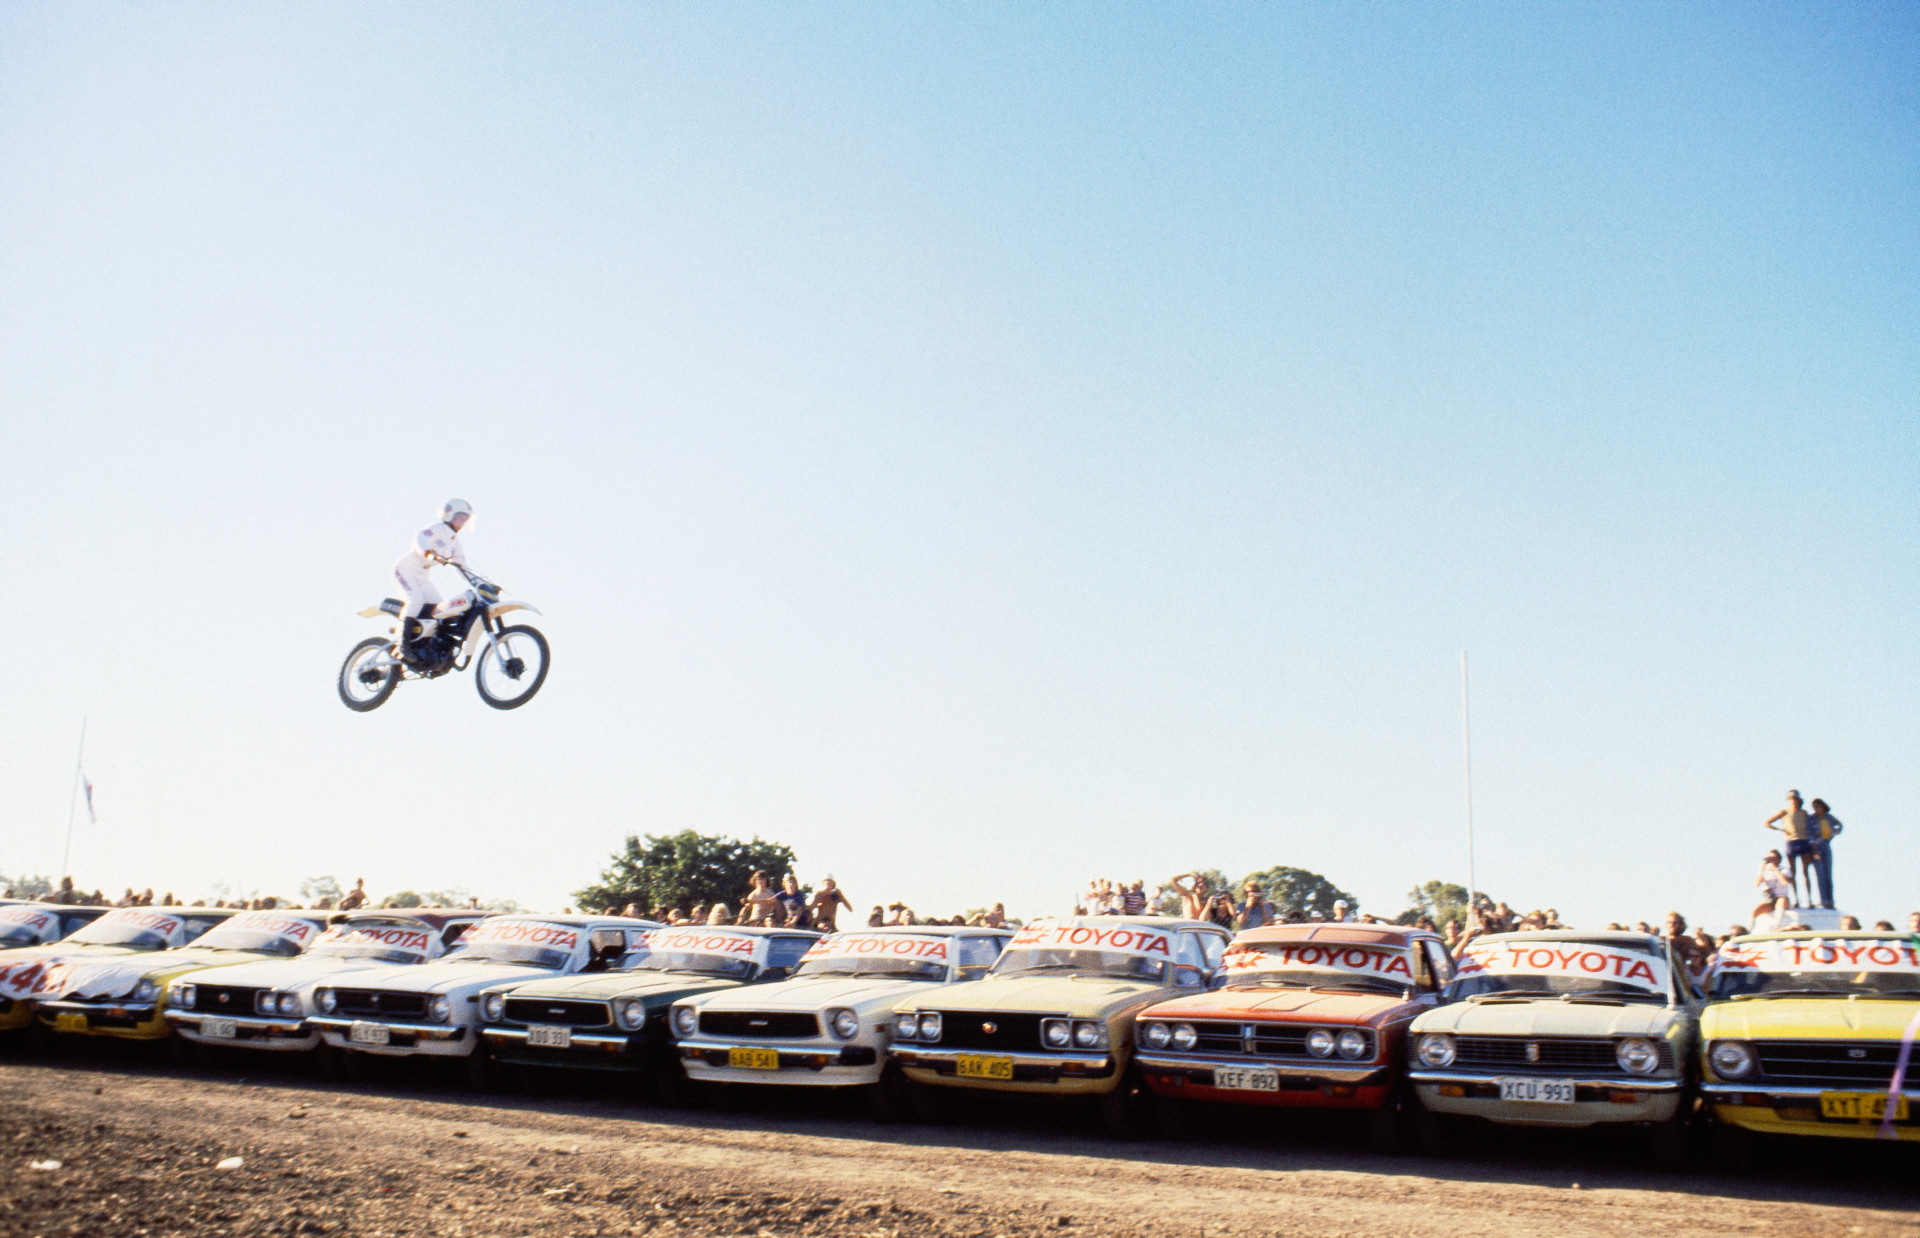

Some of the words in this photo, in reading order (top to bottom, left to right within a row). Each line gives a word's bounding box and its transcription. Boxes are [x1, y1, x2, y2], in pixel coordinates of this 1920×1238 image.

[490, 925, 579, 949] TOYOTA
[661, 933, 754, 955] TOYOTA
[839, 937, 948, 960] TOYOTA
[1055, 926, 1171, 956] TOYOTA
[1279, 945, 1413, 979] TOYOTA
[1507, 948, 1658, 986] TOYOTA
[1502, 1081, 1574, 1101] XCU-993
